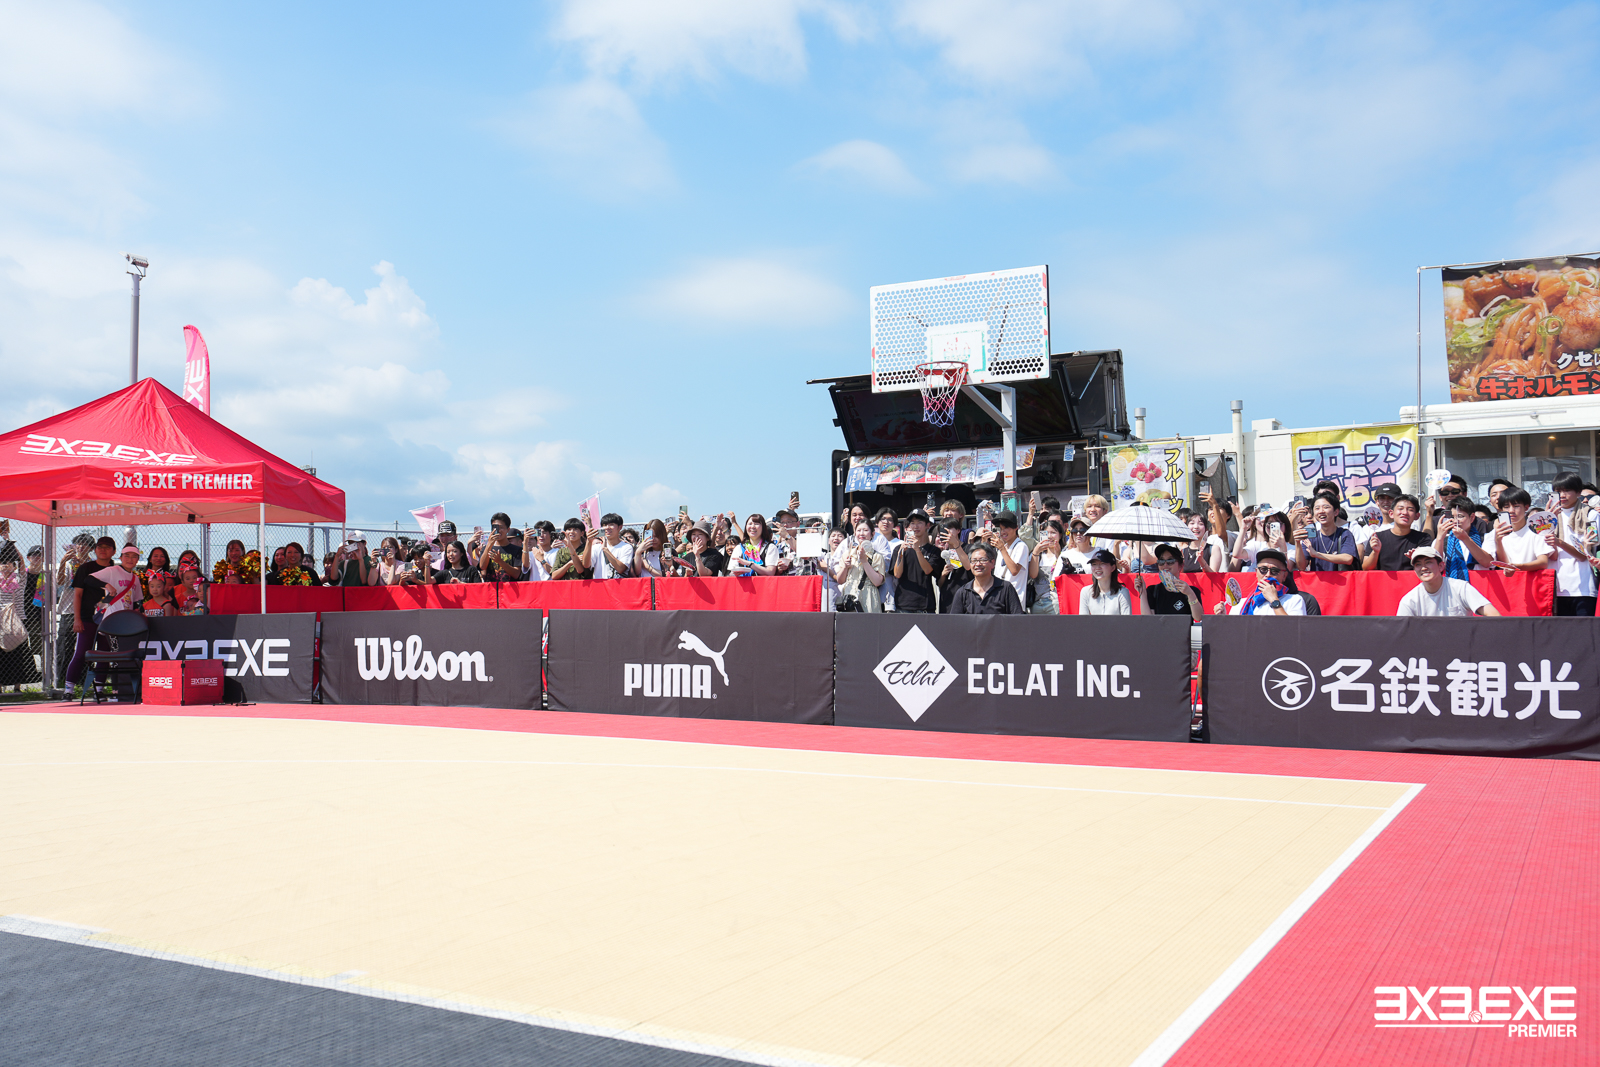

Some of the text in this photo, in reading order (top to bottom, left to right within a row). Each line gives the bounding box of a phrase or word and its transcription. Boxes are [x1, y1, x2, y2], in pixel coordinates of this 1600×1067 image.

[1298, 436, 1412, 480] フローズン
[113, 471, 253, 490] 3x3.EXE PREMIER
[1164, 448, 1184, 514] フルーツ
[354, 634, 488, 682] Wilson
[883, 660, 945, 686] Eclat
[624, 663, 712, 699] PUMA
[1320, 657, 1582, 720] 名鉄観光
